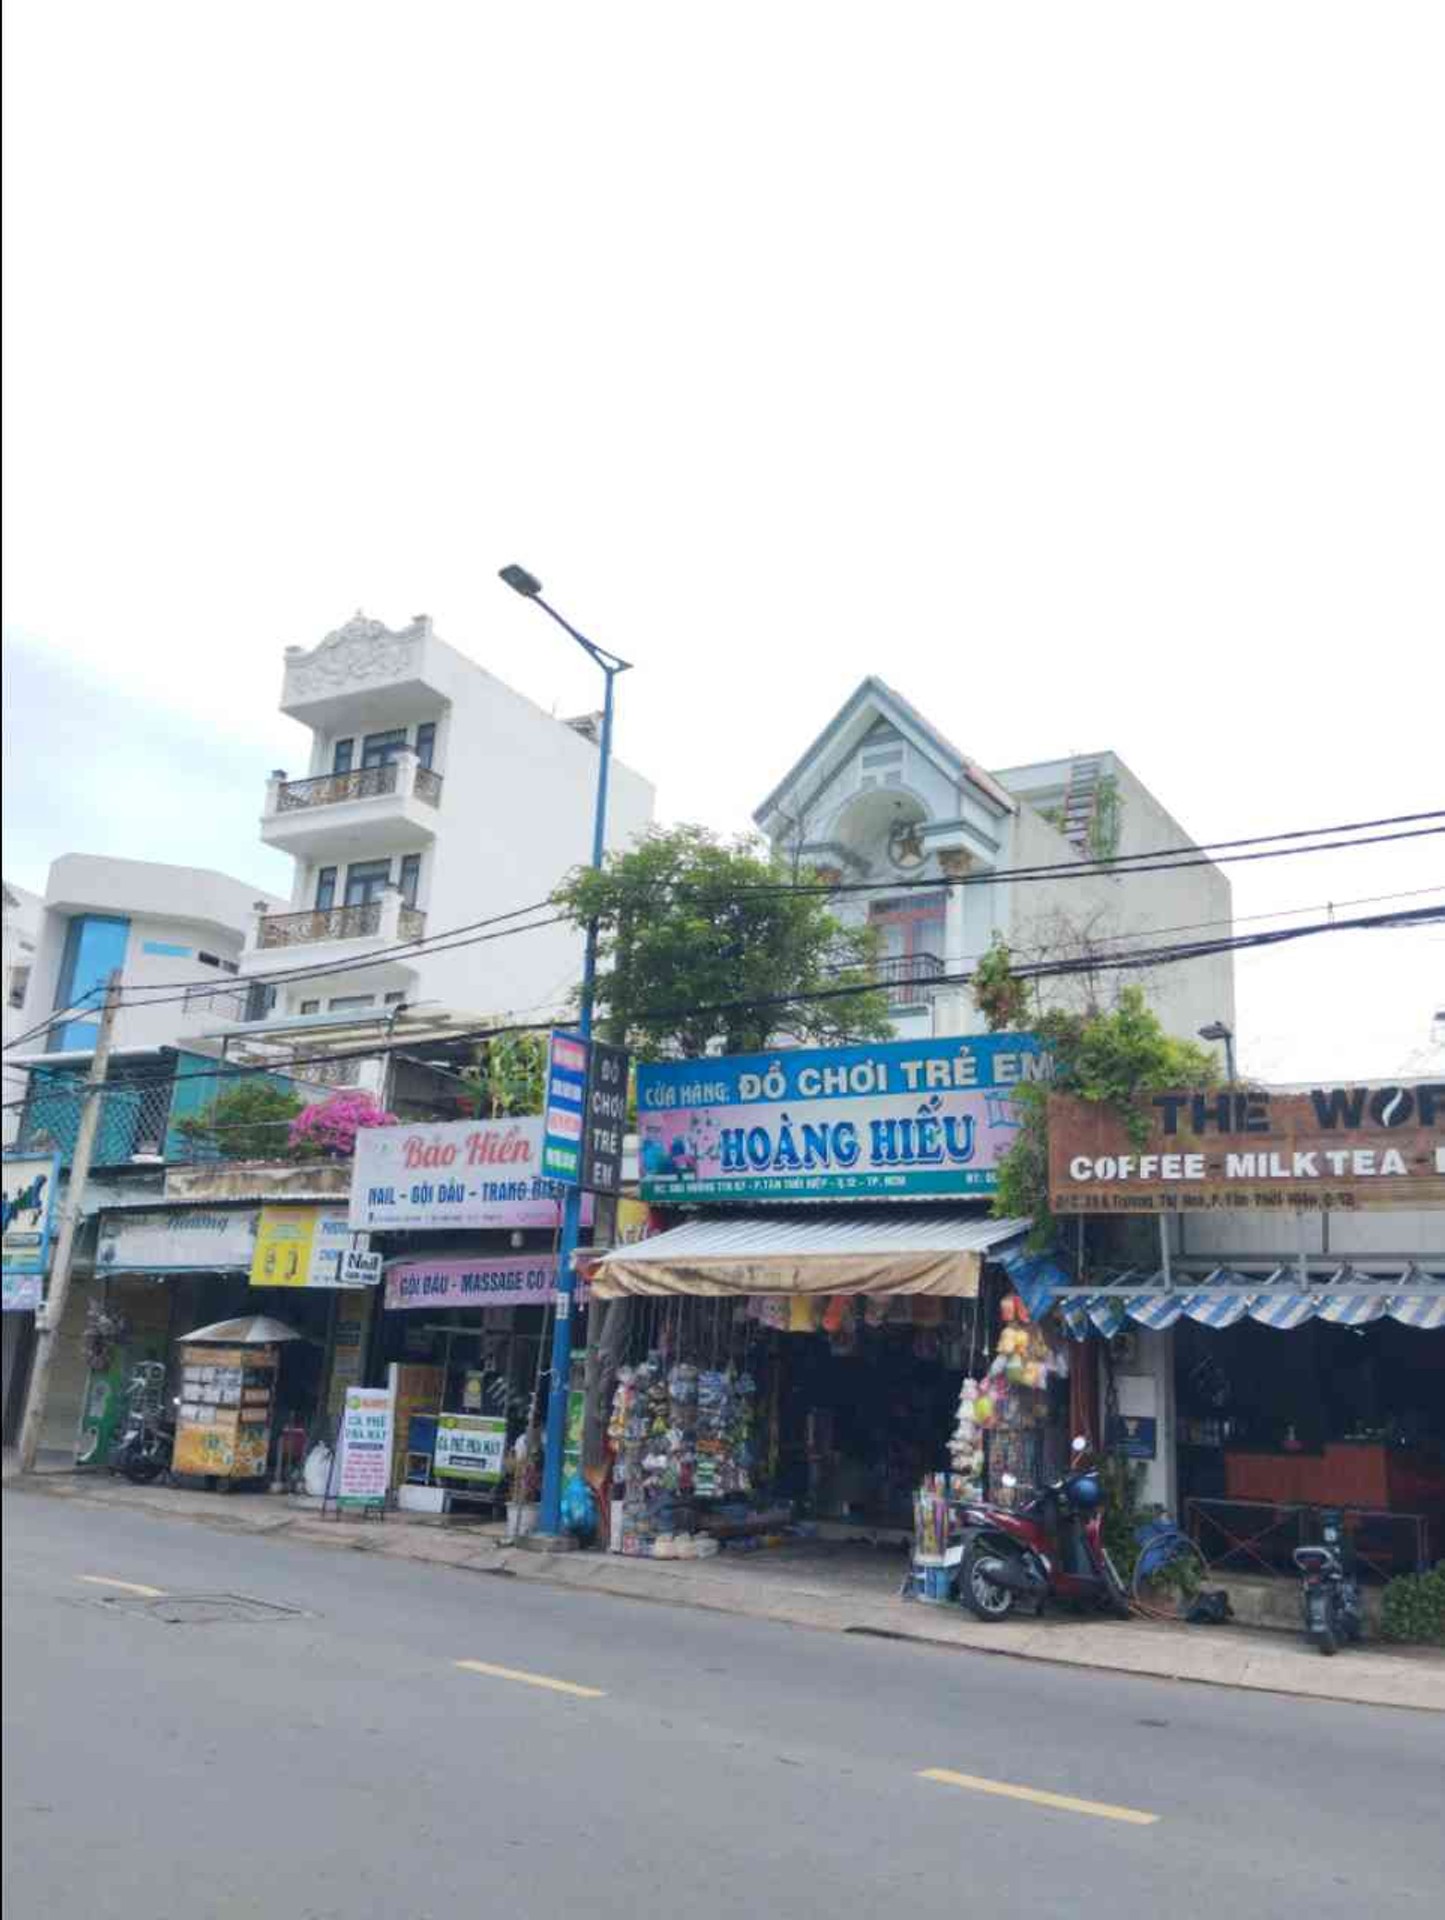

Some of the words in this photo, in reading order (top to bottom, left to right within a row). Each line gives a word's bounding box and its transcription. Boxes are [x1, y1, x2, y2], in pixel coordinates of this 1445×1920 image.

[645, 1080, 677, 1107] CỬA
[739, 1060, 787, 1101] ĐỒ
[798, 1058, 888, 1097] CHƠI
[900, 1045, 978, 1089] TRẺ
[992, 1051, 1056, 1083] EM
[1152, 1091, 1270, 1135] THE
[402, 1133, 457, 1168] Bảo
[720, 1111, 860, 1172] HOÀNG
[869, 1094, 975, 1167] HIẾU
[1069, 1153, 1206, 1181] COFFEE
[1225, 1151, 1319, 1178] MILK
[1325, 1148, 1408, 1176] TEA
[367, 1185, 396, 1206] NAIL
[410, 1180, 434, 1206] GỘI
[482, 1180, 527, 1201] TRANG
[461, 1270, 523, 1294] MASSAGE
